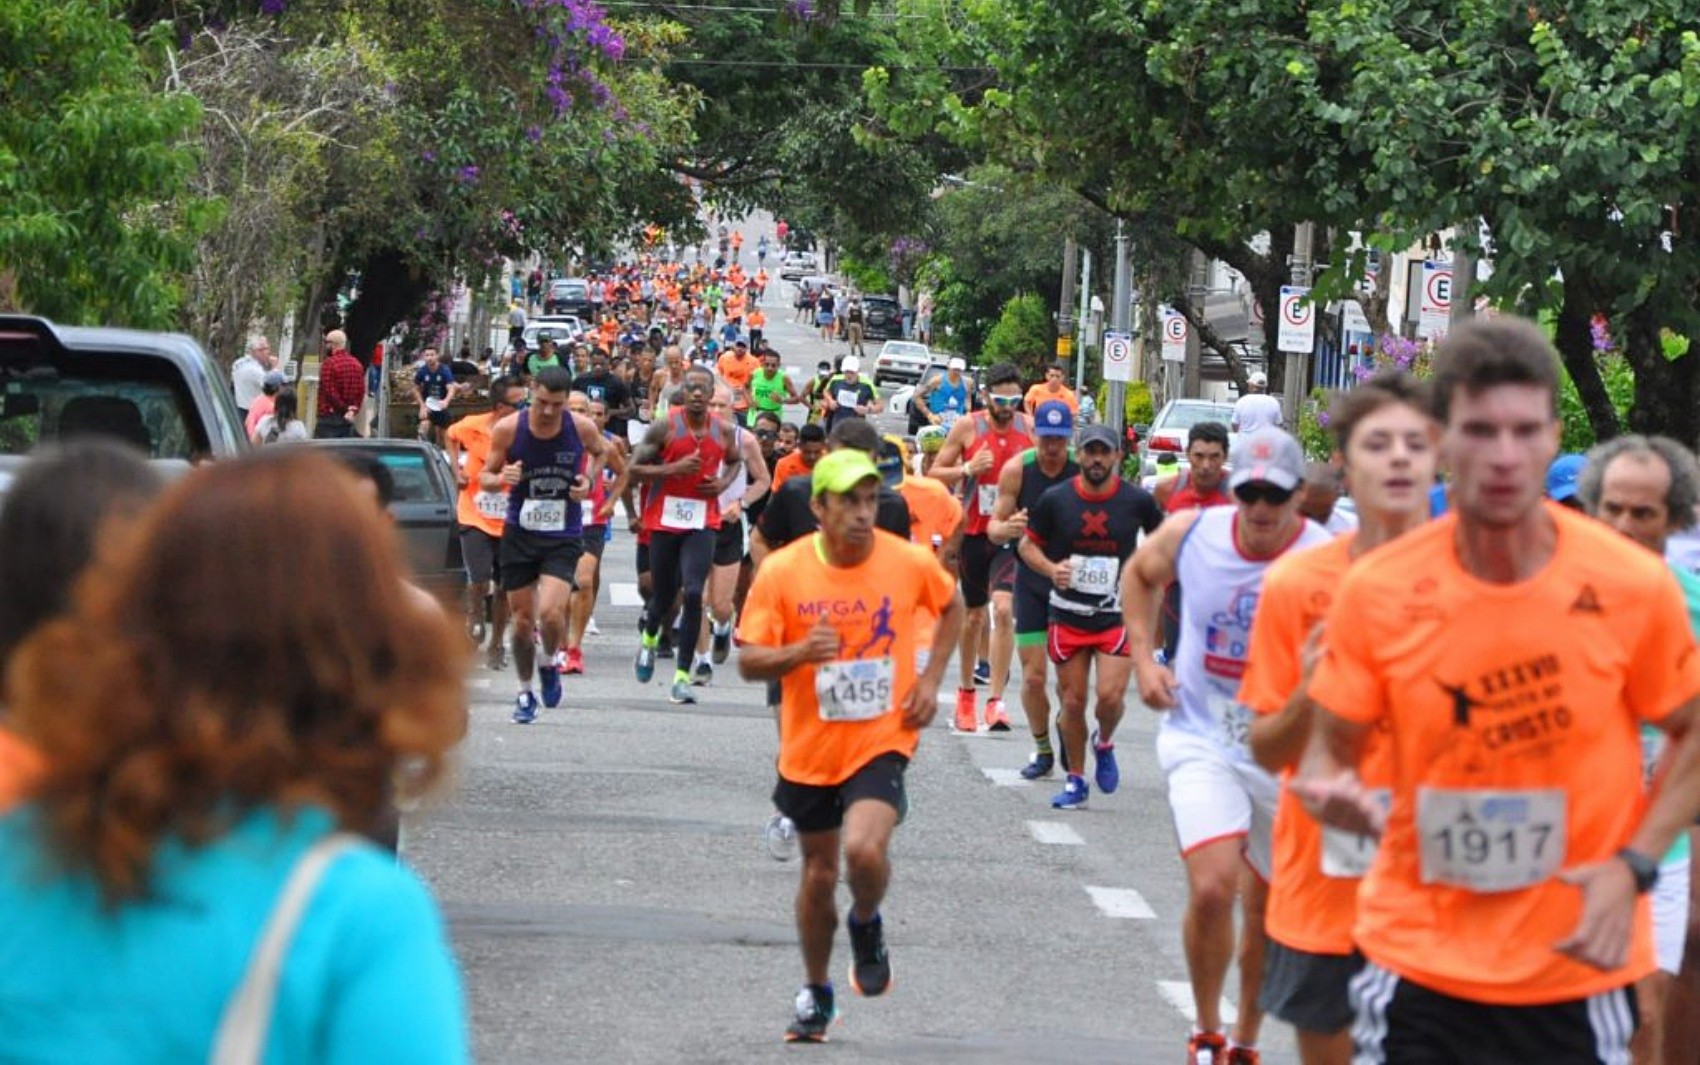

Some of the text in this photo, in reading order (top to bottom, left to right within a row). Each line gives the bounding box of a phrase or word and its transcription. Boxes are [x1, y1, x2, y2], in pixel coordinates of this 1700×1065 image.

[1437, 280, 1449, 300] E
[1292, 303, 1302, 319] E
[1173, 322, 1182, 335] E
[1113, 345, 1122, 357] E
[526, 511, 561, 523] 1052
[676, 509, 693, 522] 50
[1078, 570, 1109, 585] 268
[798, 600, 866, 616] MEGA
[829, 678, 890, 704] 1455
[1434, 823, 1553, 865] 1917
